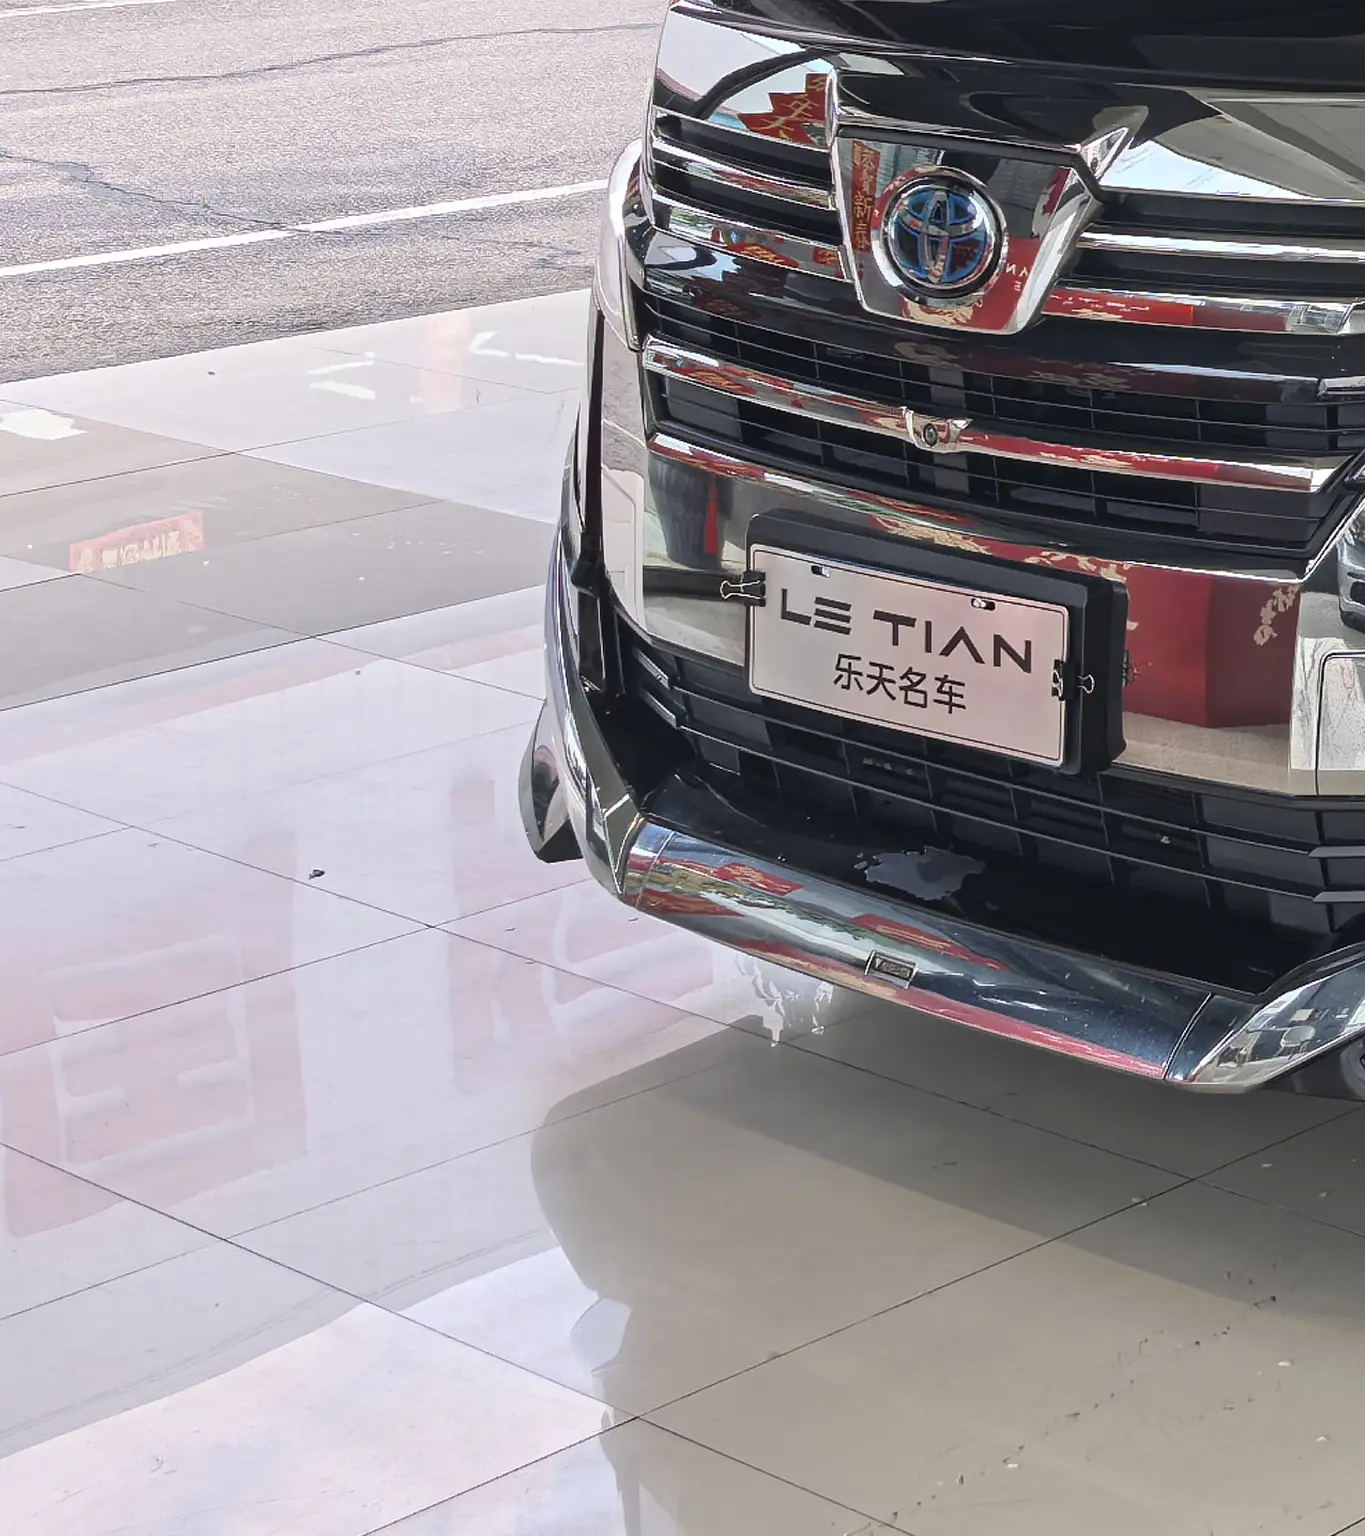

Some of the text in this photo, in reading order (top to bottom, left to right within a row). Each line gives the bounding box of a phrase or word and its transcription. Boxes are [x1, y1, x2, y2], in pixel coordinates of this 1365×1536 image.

[780, 587, 1032, 675] LE TIAN
[832, 653, 967, 715] 乐天名车
